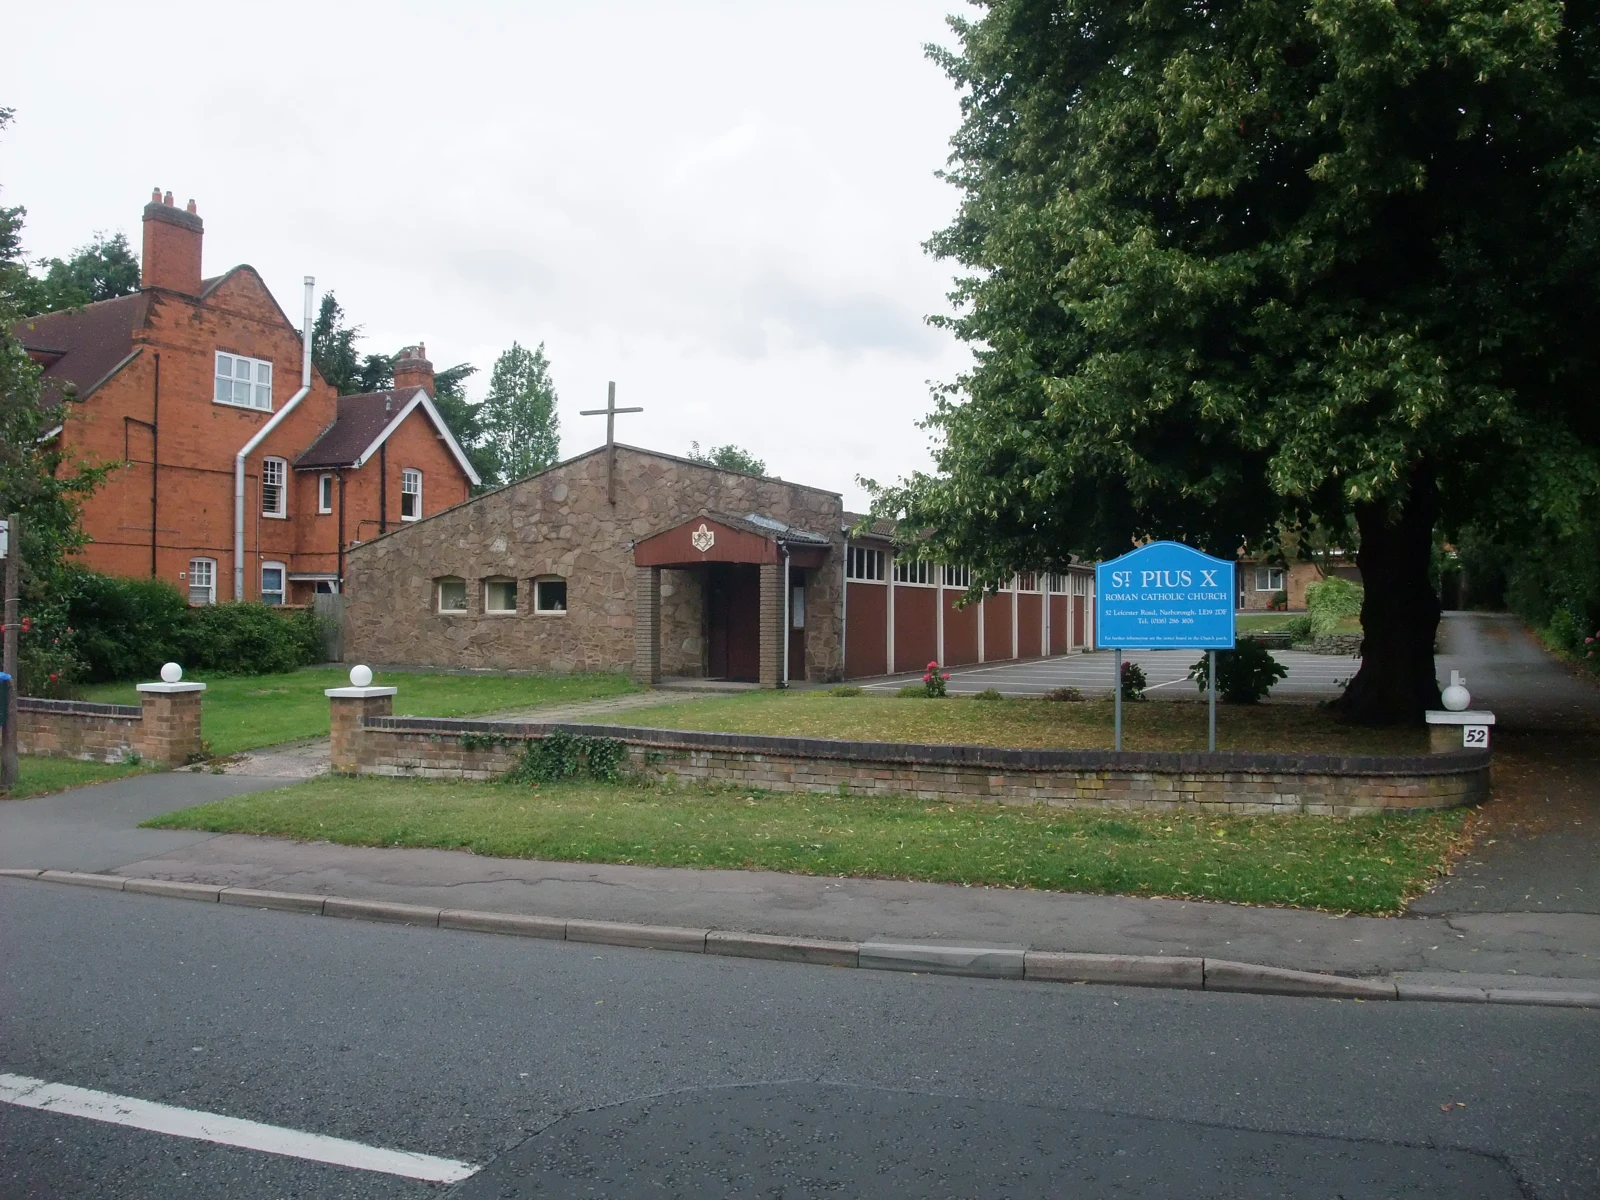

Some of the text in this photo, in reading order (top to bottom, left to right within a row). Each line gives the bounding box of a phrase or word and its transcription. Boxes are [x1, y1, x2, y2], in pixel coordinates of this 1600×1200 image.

[1140, 570, 1192, 587] PIUS
[1200, 570, 1218, 587] X
[1188, 592, 1227, 600] CHURCH
[1466, 730, 1486, 742] 52
